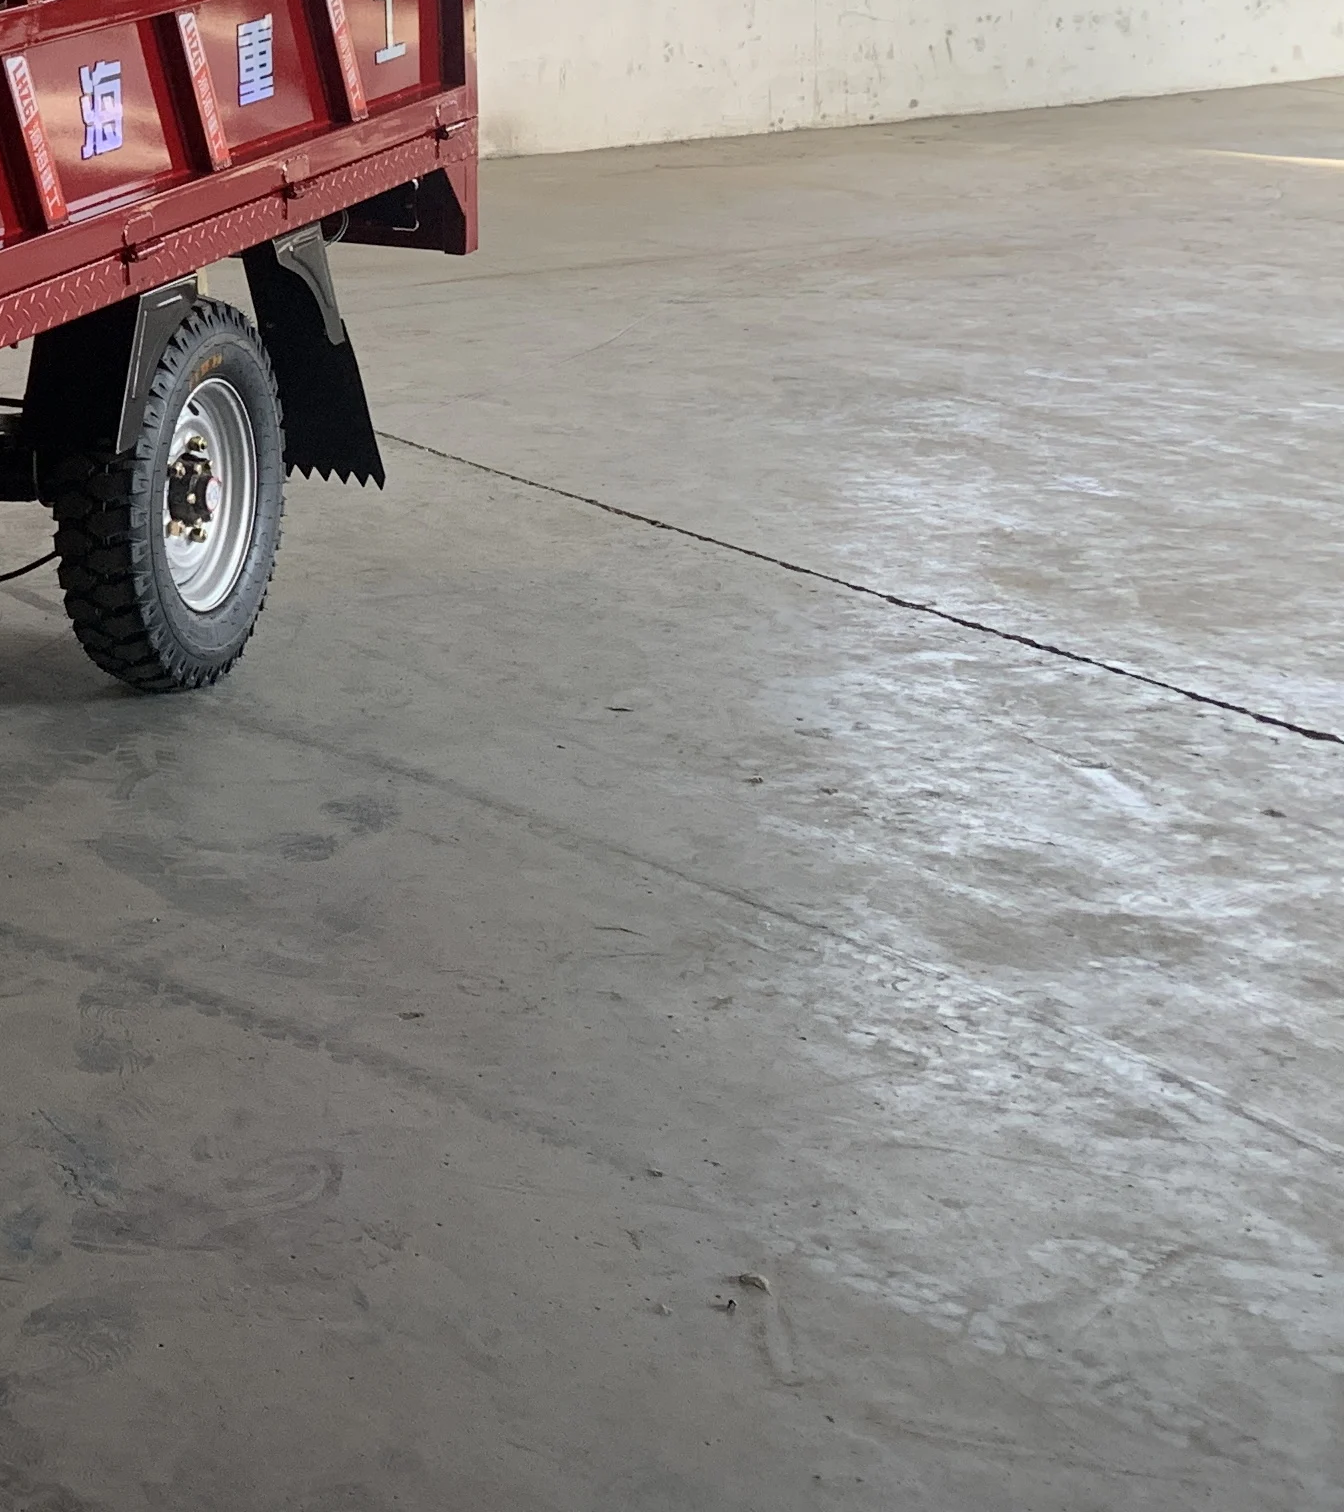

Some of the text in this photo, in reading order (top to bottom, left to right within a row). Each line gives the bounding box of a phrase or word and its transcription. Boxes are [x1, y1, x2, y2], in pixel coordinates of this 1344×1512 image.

[12, 60, 36, 119] LHZG
[79, 60, 123, 160] 海
[236, 13, 274, 108] 重
